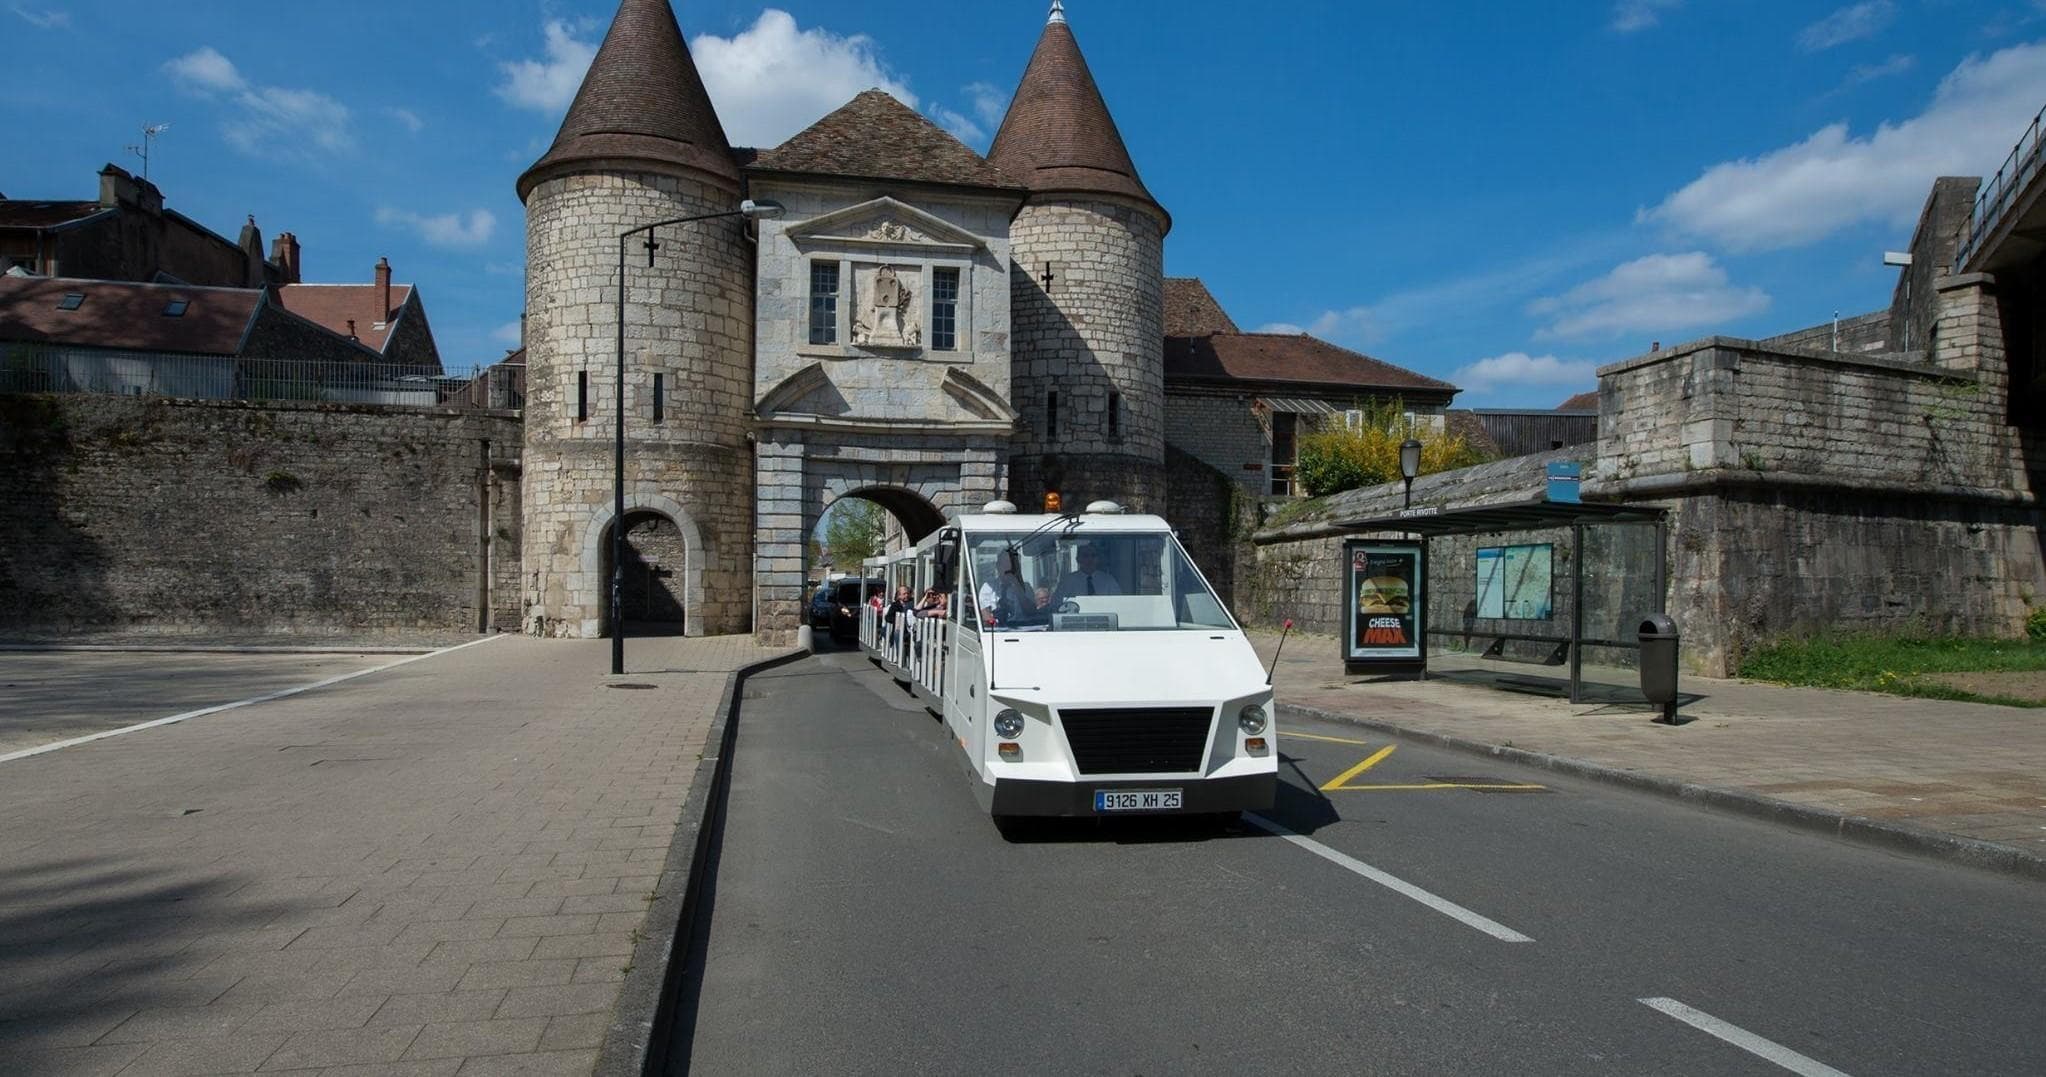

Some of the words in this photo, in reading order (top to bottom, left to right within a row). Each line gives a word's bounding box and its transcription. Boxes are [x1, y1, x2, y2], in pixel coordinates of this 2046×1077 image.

[1399, 509, 1416, 518] PORTE
[1368, 617, 1401, 629] CHEESE
[1361, 627, 1408, 645] MAX
[1106, 794, 1137, 808] 9126
[1143, 793, 1158, 807] XH
[1163, 793, 1179, 807] 25
